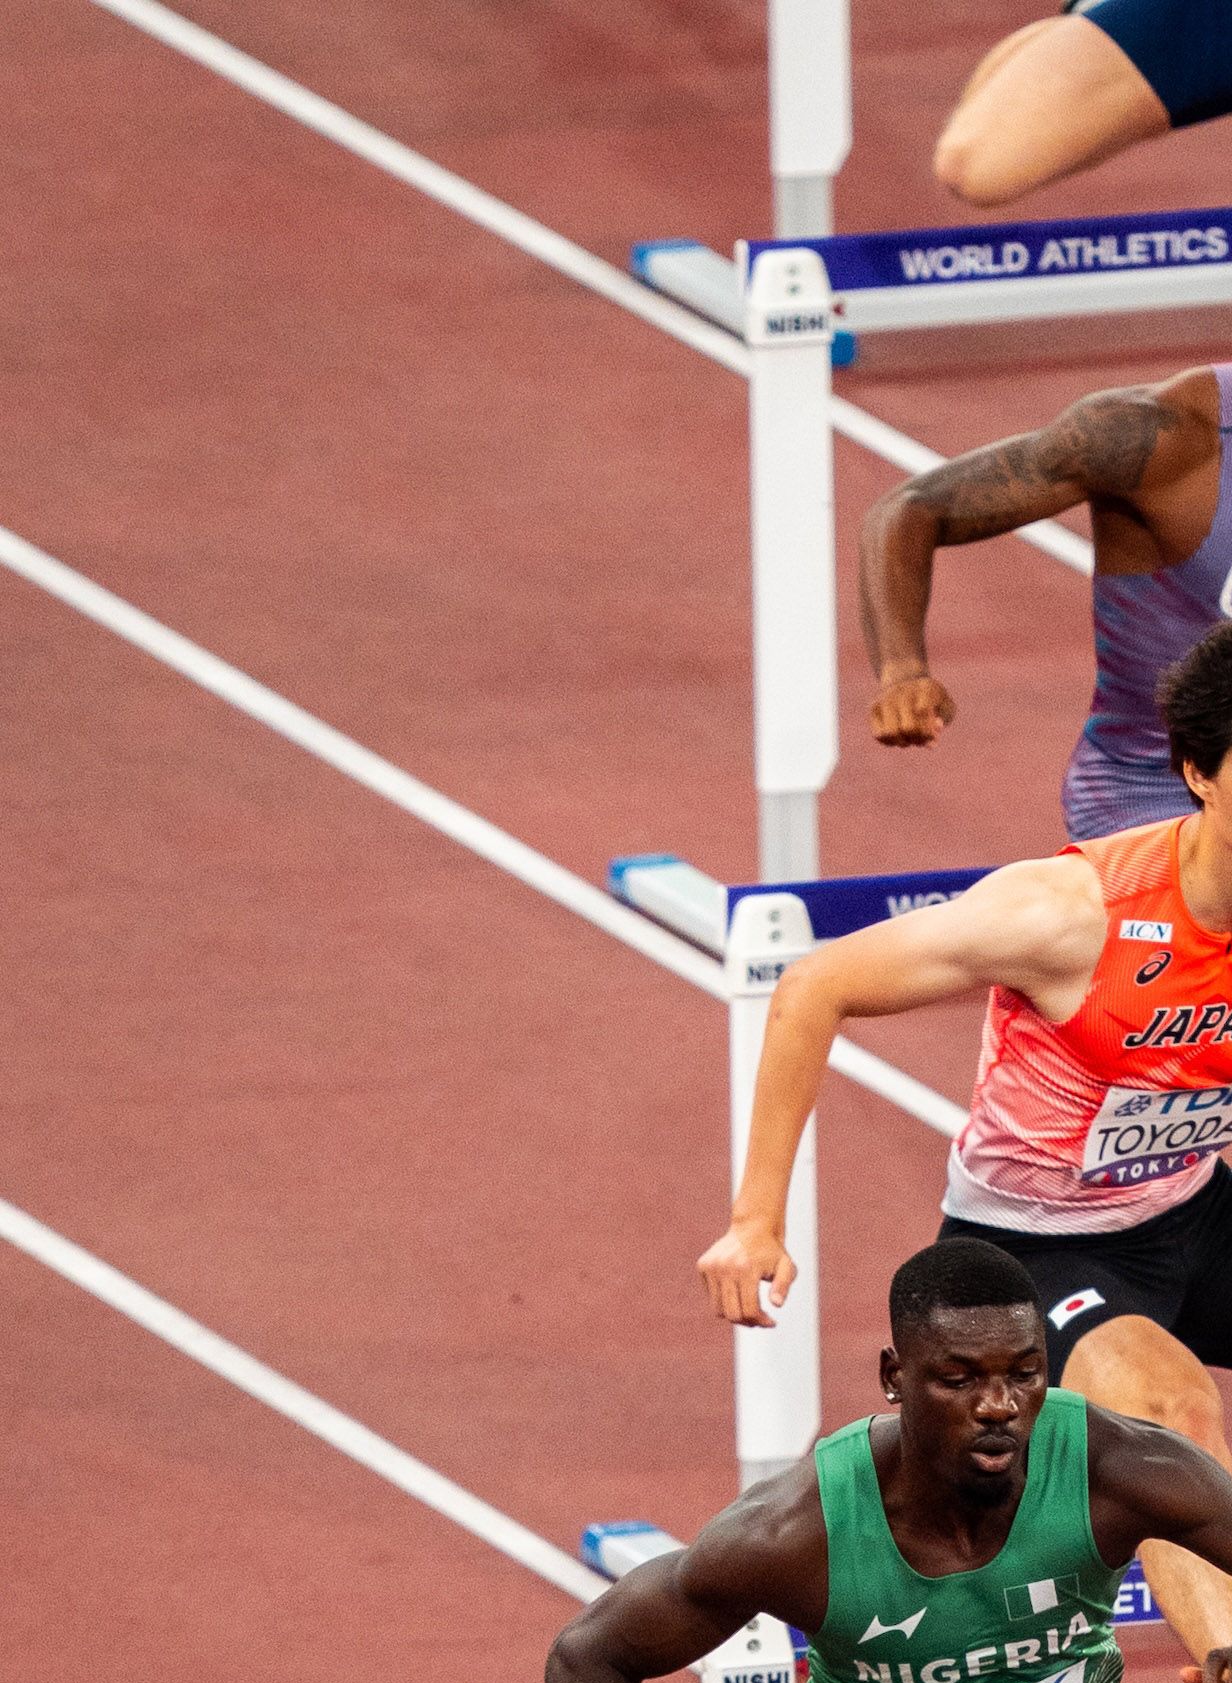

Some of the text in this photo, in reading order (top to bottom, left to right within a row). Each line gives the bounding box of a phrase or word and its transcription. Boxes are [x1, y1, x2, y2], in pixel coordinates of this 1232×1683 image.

[900, 243, 1029, 280] WORLD
[1037, 227, 1228, 271] ATHLETICS
[1122, 923, 1169, 939] ACN
